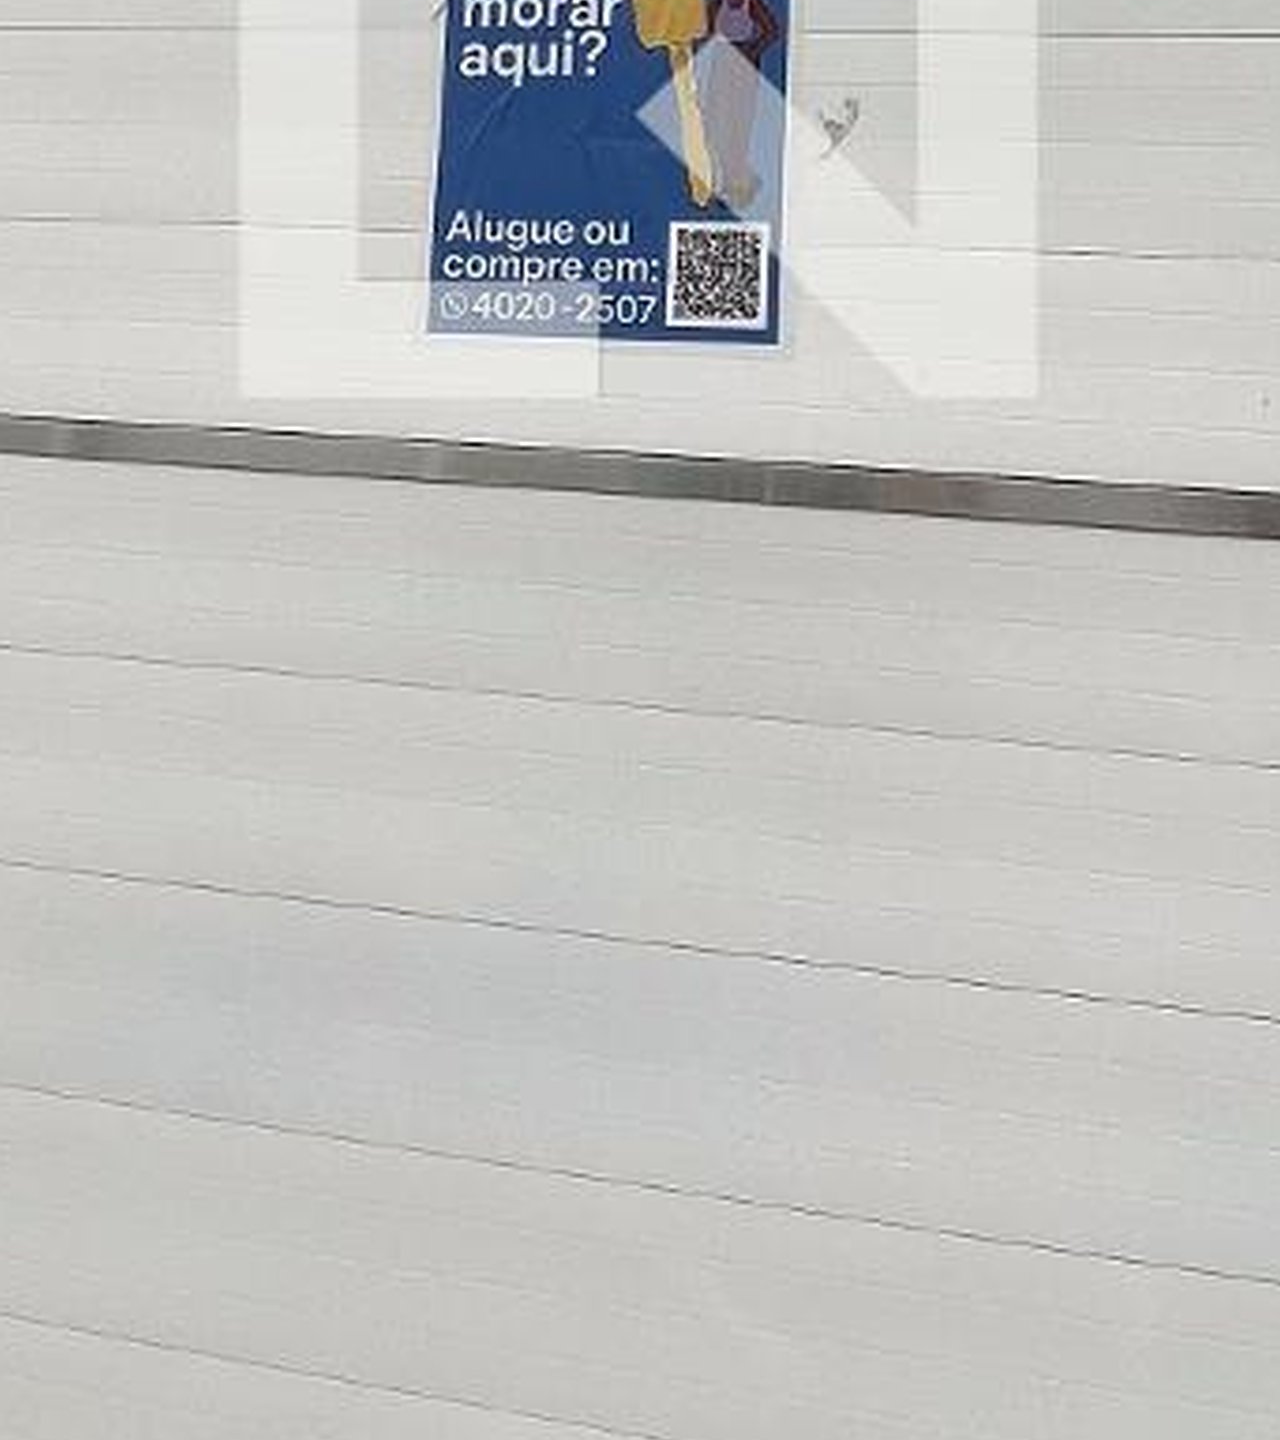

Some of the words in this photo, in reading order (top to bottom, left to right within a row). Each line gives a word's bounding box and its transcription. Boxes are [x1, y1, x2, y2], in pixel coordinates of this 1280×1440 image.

[458, 29, 609, 87] aqui?
[444, 209, 576, 250] Alugue
[584, 219, 631, 245] ou
[442, 251, 583, 285] compre
[591, 256, 660, 283] em:
[470, 290, 658, 324] 4020-2507
